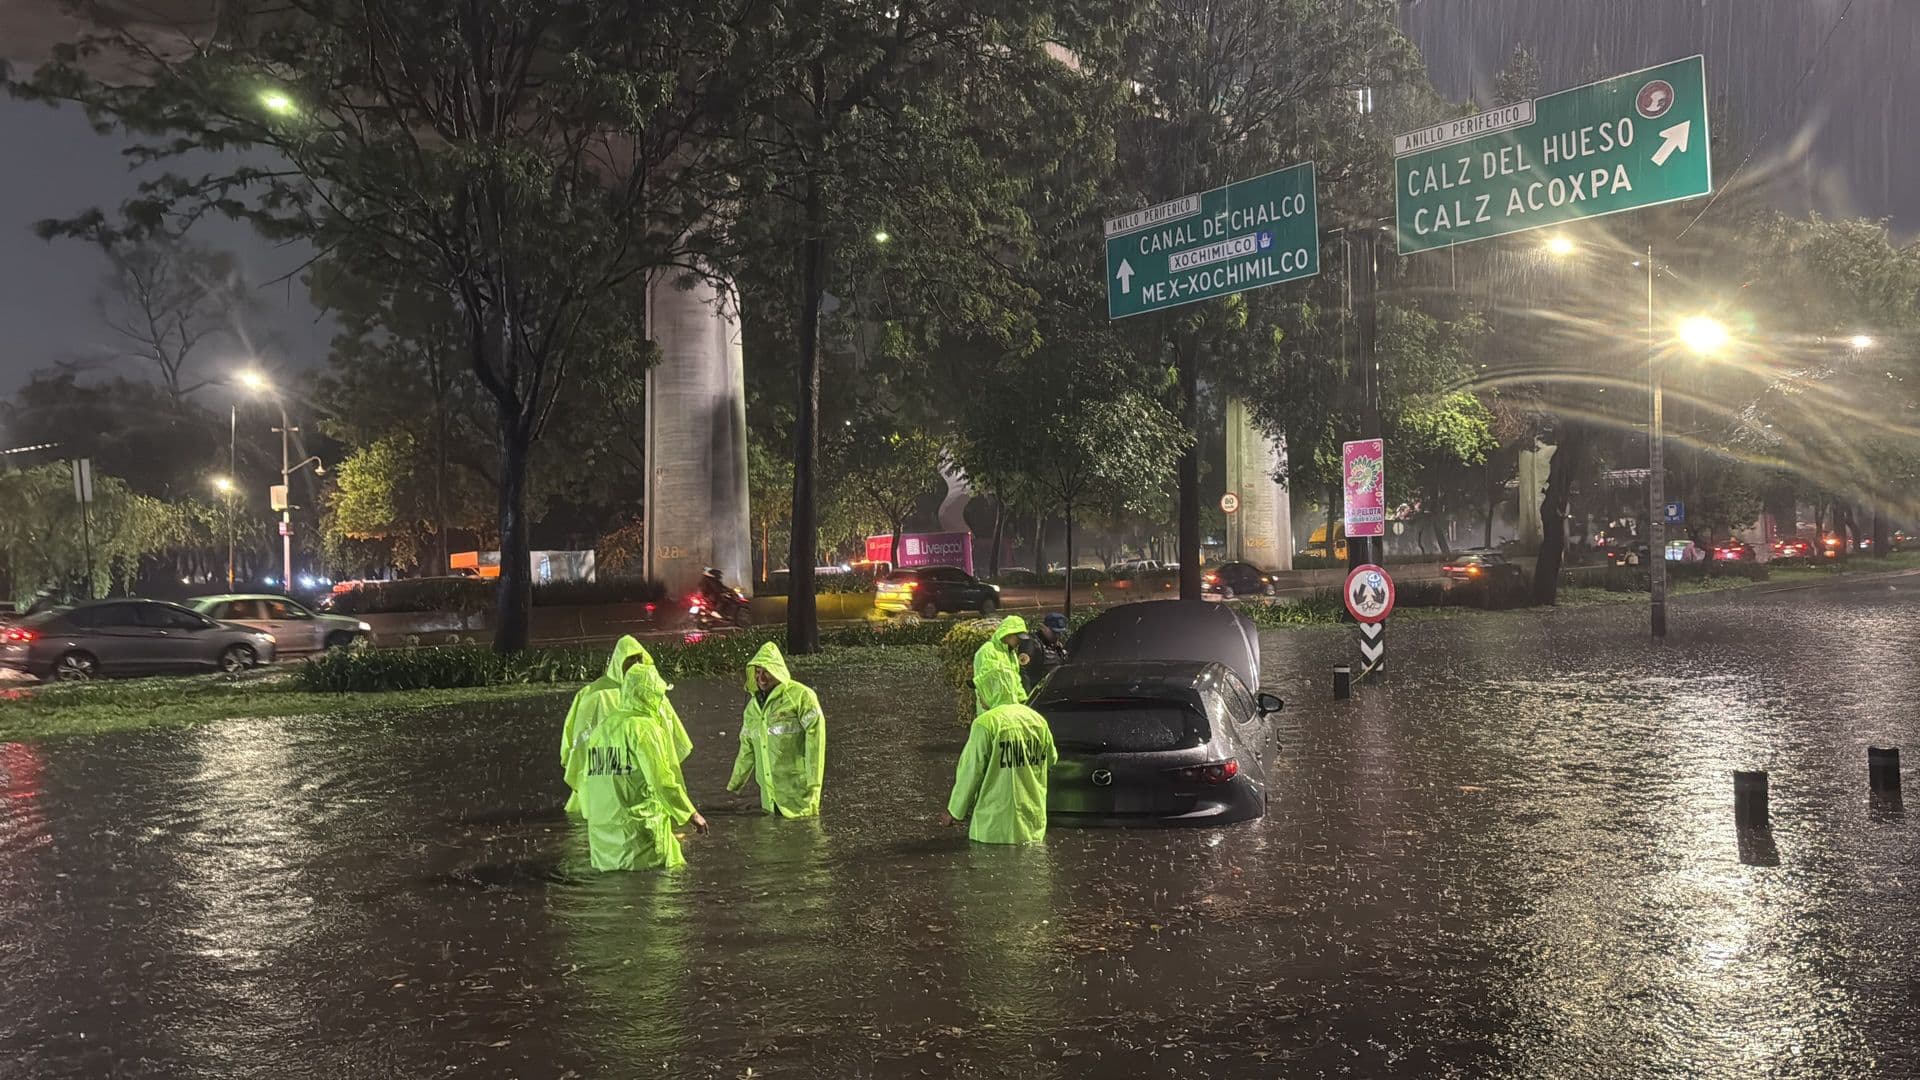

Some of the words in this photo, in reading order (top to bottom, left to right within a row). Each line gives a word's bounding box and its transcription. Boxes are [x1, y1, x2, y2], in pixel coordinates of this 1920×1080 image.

[1405, 127, 1443, 150] ANILLO
[1452, 106, 1520, 137] PERIFERICO
[1407, 157, 1471, 197] CALZ
[1483, 144, 1531, 180] DEL
[1543, 117, 1634, 165] HUESO
[1112, 215, 1139, 233] ANILLO
[1144, 199, 1191, 223] PERIFERICO
[1414, 194, 1491, 235] CALZ
[1505, 164, 1632, 217] ACOXPA
[1140, 226, 1197, 255] CANAL
[1203, 217, 1225, 239] DE
[1231, 193, 1306, 231] CHALCO
[1143, 248, 1308, 304] MEX-XOCHIMILCO
[1174, 243, 1252, 268] XOCHIMILCO
[921, 540, 963, 557] Liverpool
[999, 741, 1025, 768] ZONA
